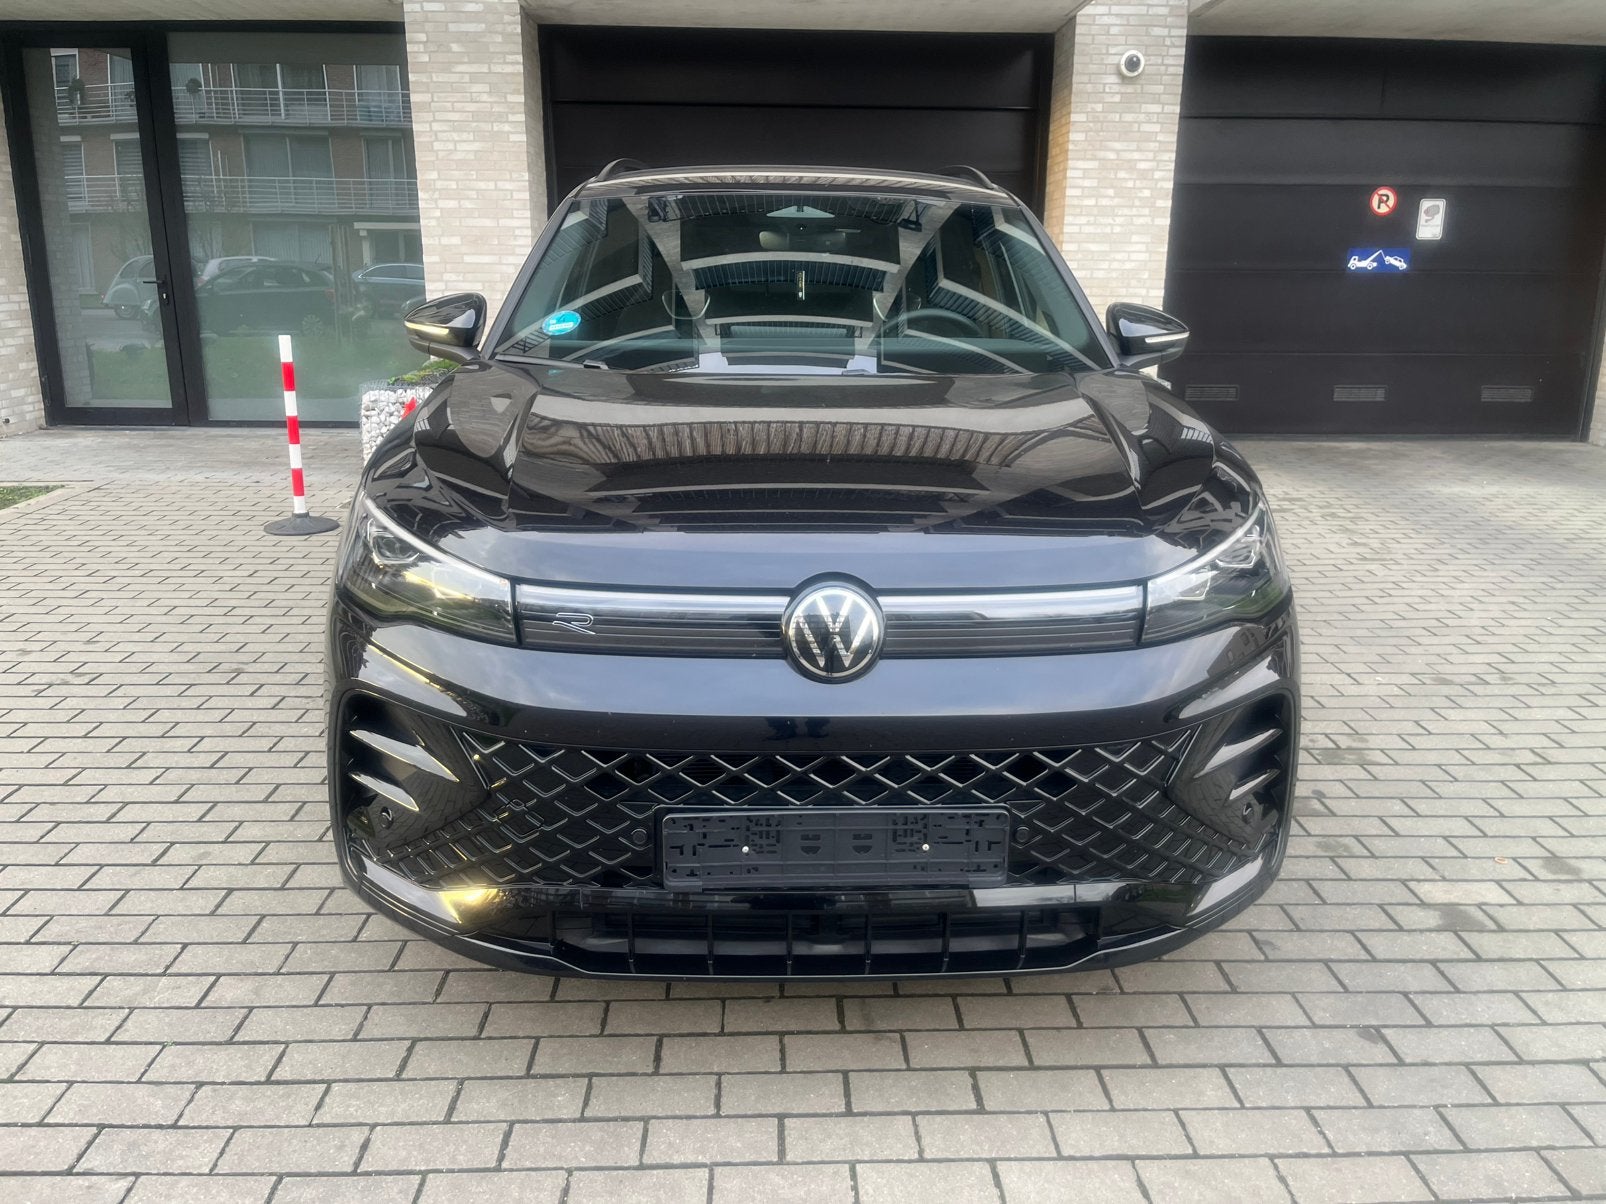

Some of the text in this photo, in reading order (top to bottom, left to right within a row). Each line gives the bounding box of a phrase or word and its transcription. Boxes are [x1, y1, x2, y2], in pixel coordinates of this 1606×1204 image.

[1377, 193, 1390, 210] P
[551, 612, 597, 635] R
[793, 590, 877, 671] VW
